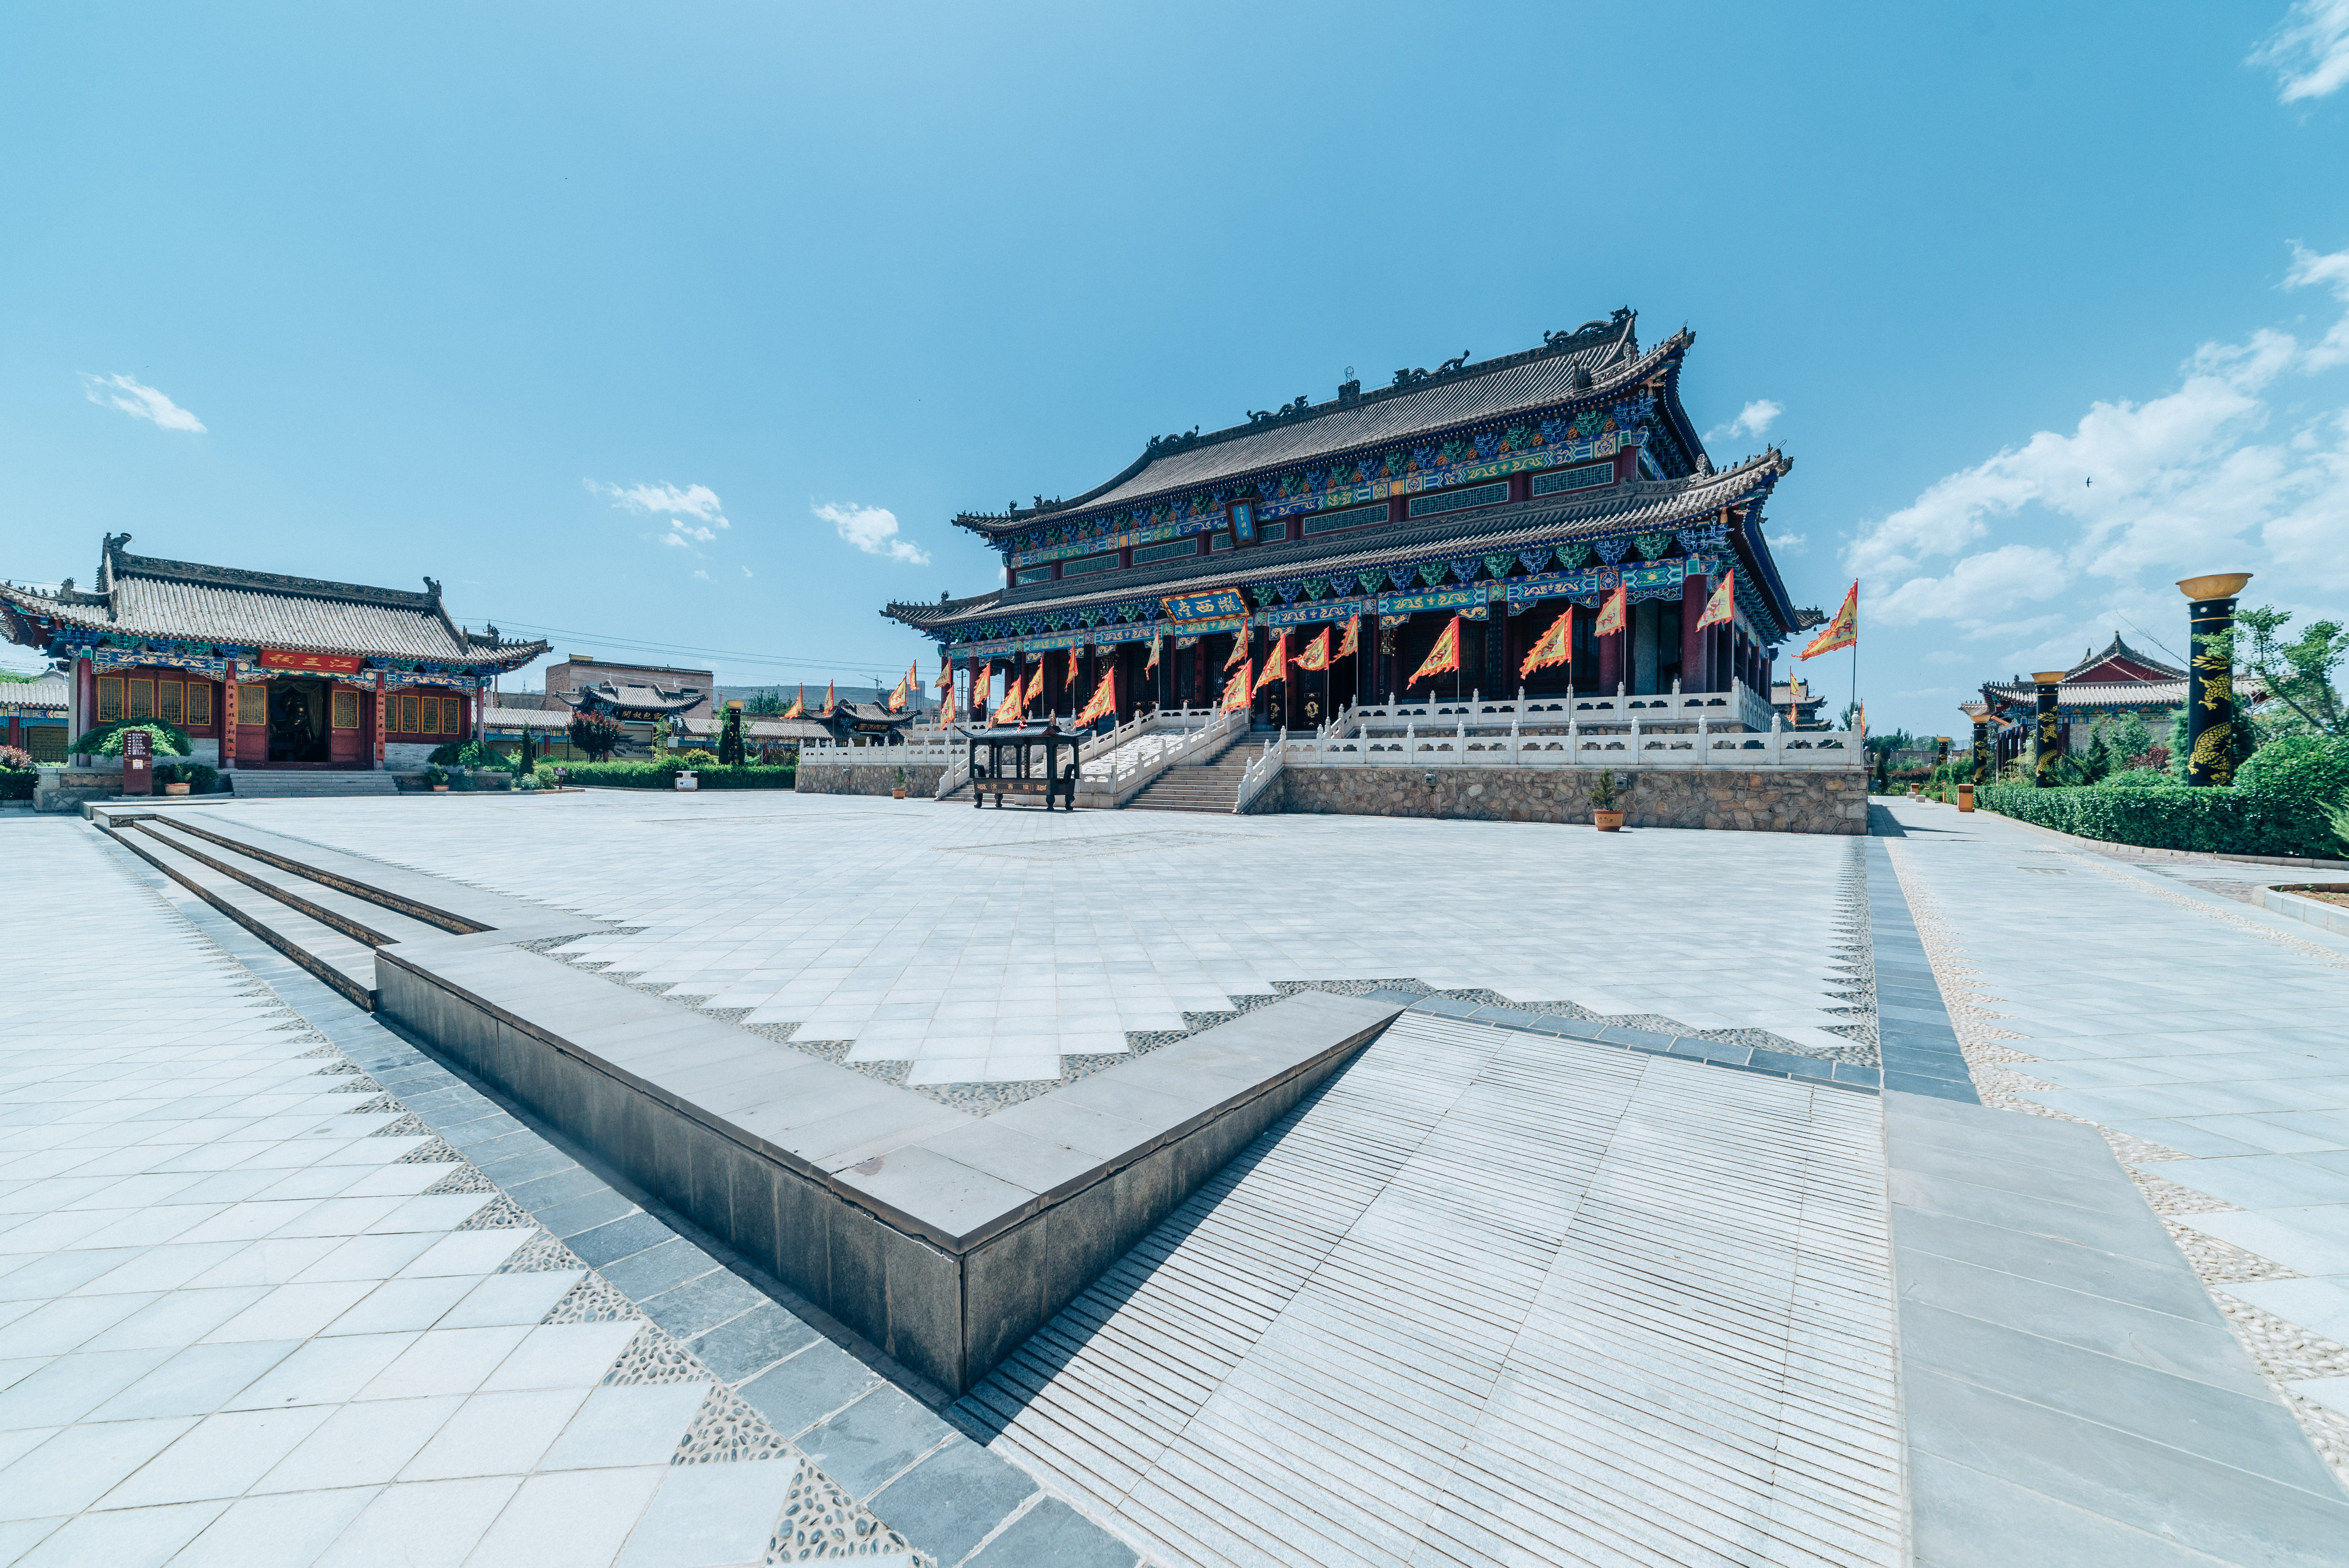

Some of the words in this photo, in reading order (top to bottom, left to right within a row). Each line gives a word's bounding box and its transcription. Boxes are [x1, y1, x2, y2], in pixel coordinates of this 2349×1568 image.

[1178, 595, 1240, 617] 隴西堂
[269, 654, 353, 668] 江王祠
